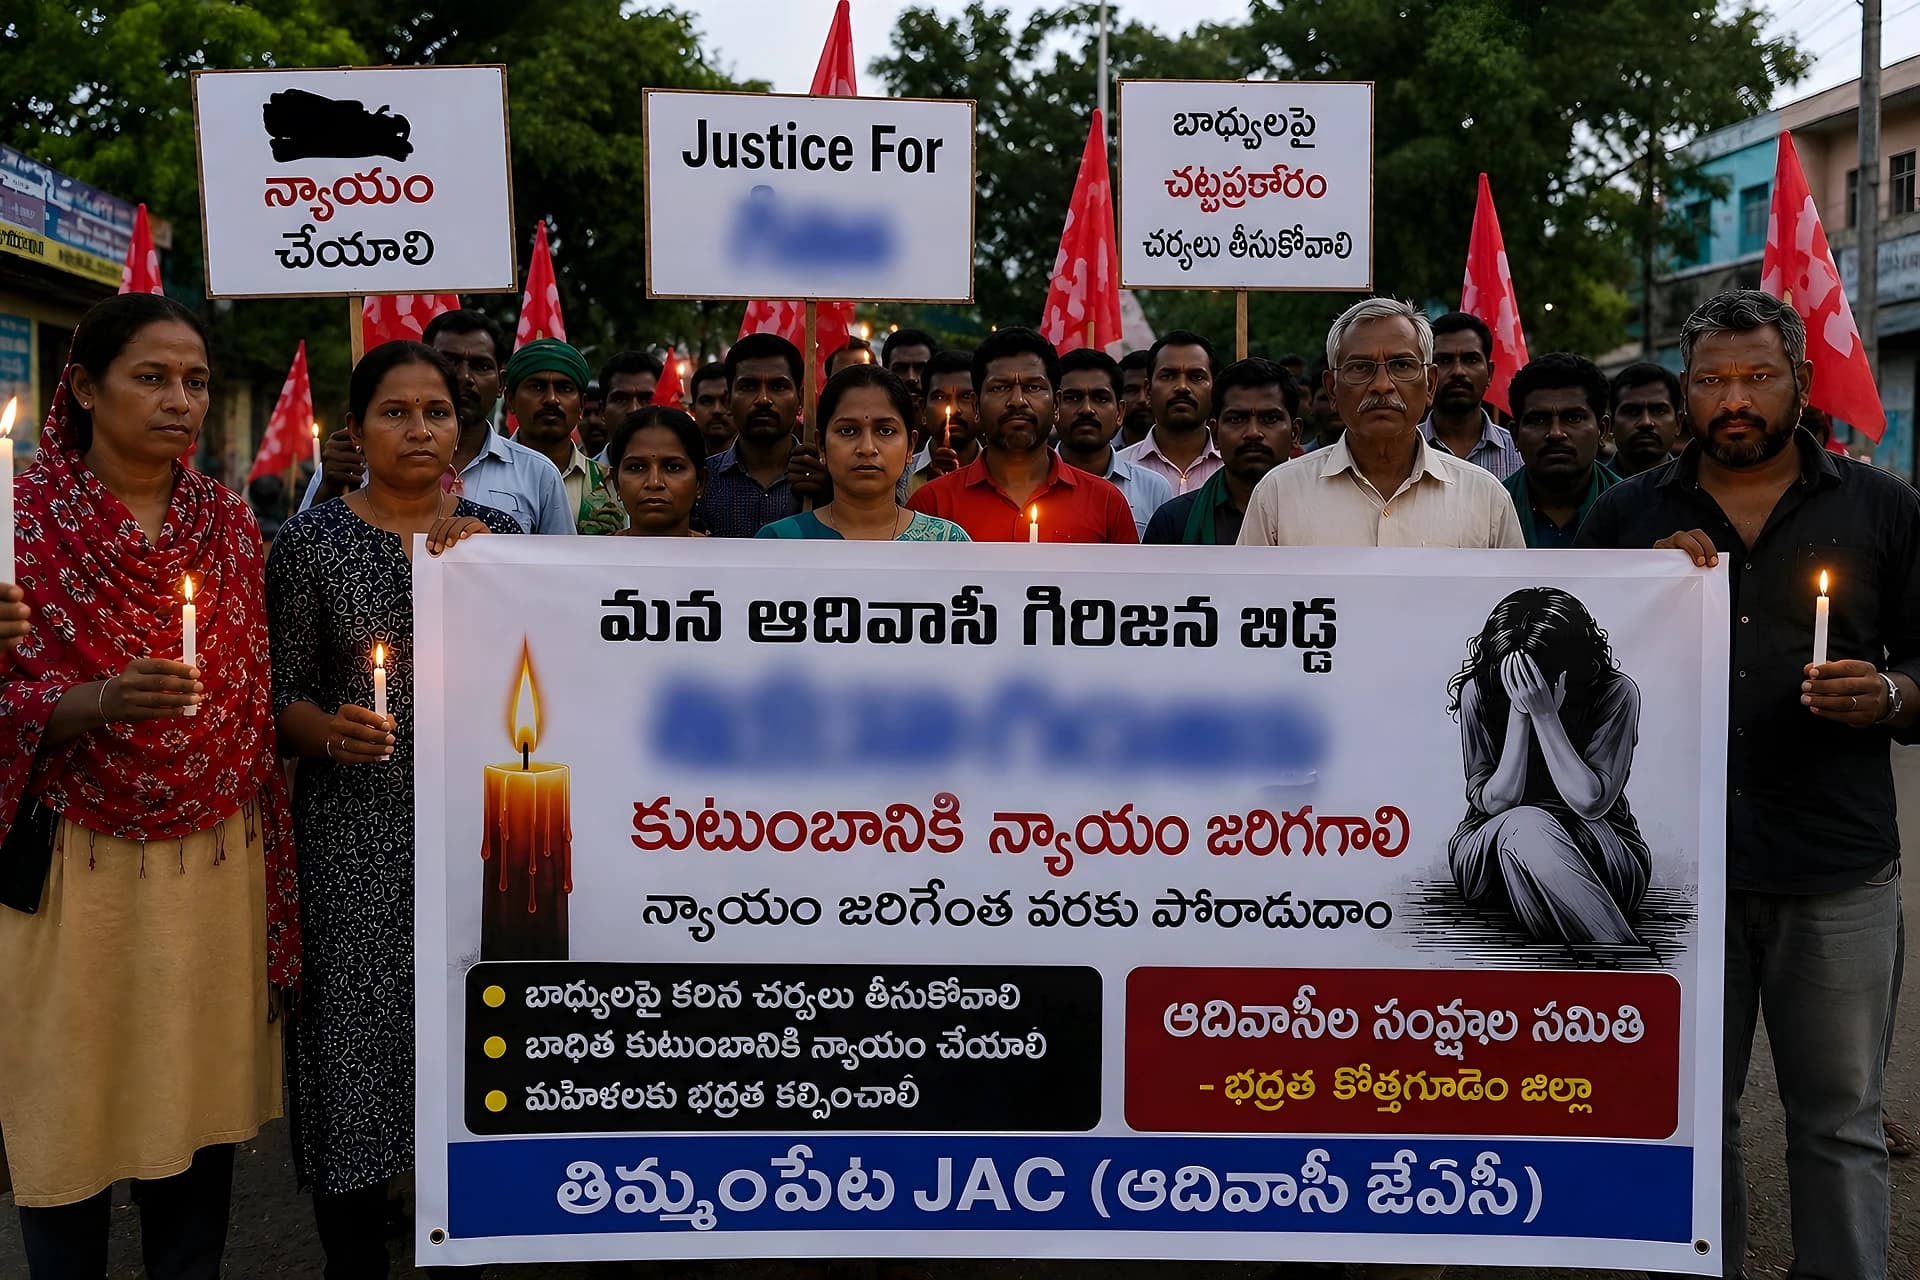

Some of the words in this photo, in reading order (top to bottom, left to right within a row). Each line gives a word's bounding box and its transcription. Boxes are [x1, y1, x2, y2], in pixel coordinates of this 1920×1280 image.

[683, 119, 853, 171] Justice
[872, 125, 943, 173] For
[265, 167, 433, 221] న్యాయం
[275, 224, 434, 268] చేయాలి
[1143, 229, 1220, 270] చర్యలు
[1229, 224, 1352, 259] తీసుకోవాలి
[601, 590, 721, 641] మన
[749, 586, 997, 645] ఆదివాసీ
[1024, 586, 1217, 647] గిరిజన
[1241, 598, 1337, 673] బిడ్డ
[631, 793, 963, 853] కుటుంబానికి
[989, 804, 1189, 876] న్యాయం
[643, 888, 822, 942] న్యాయం
[839, 879, 1013, 926] జరిగేంత
[1028, 890, 1138, 927] వరకు
[1152, 888, 1393, 929] పోరాడుదాం
[525, 980, 661, 1019] బాధ్యులపై
[866, 976, 1021, 1010] తీసుకోవాలి
[1164, 985, 1359, 1039] ఆదివాసీల
[1533, 1001, 1645, 1043] సమితి
[525, 1030, 615, 1063] బాధిత
[626, 1027, 801, 1059] కుటుంబానికి
[812, 1031, 926, 1070] న్యాయం
[688, 1081, 765, 1118] భద్రత
[1225, 1069, 1316, 1111] భద్రత
[1521, 1074, 1593, 1113] జిల్లా
[556, 1144, 895, 1230] తిమ్మంపేట
[914, 1157, 1065, 1213] JAC
[1091, 1148, 1348, 1219] (ఆదివాసీ
